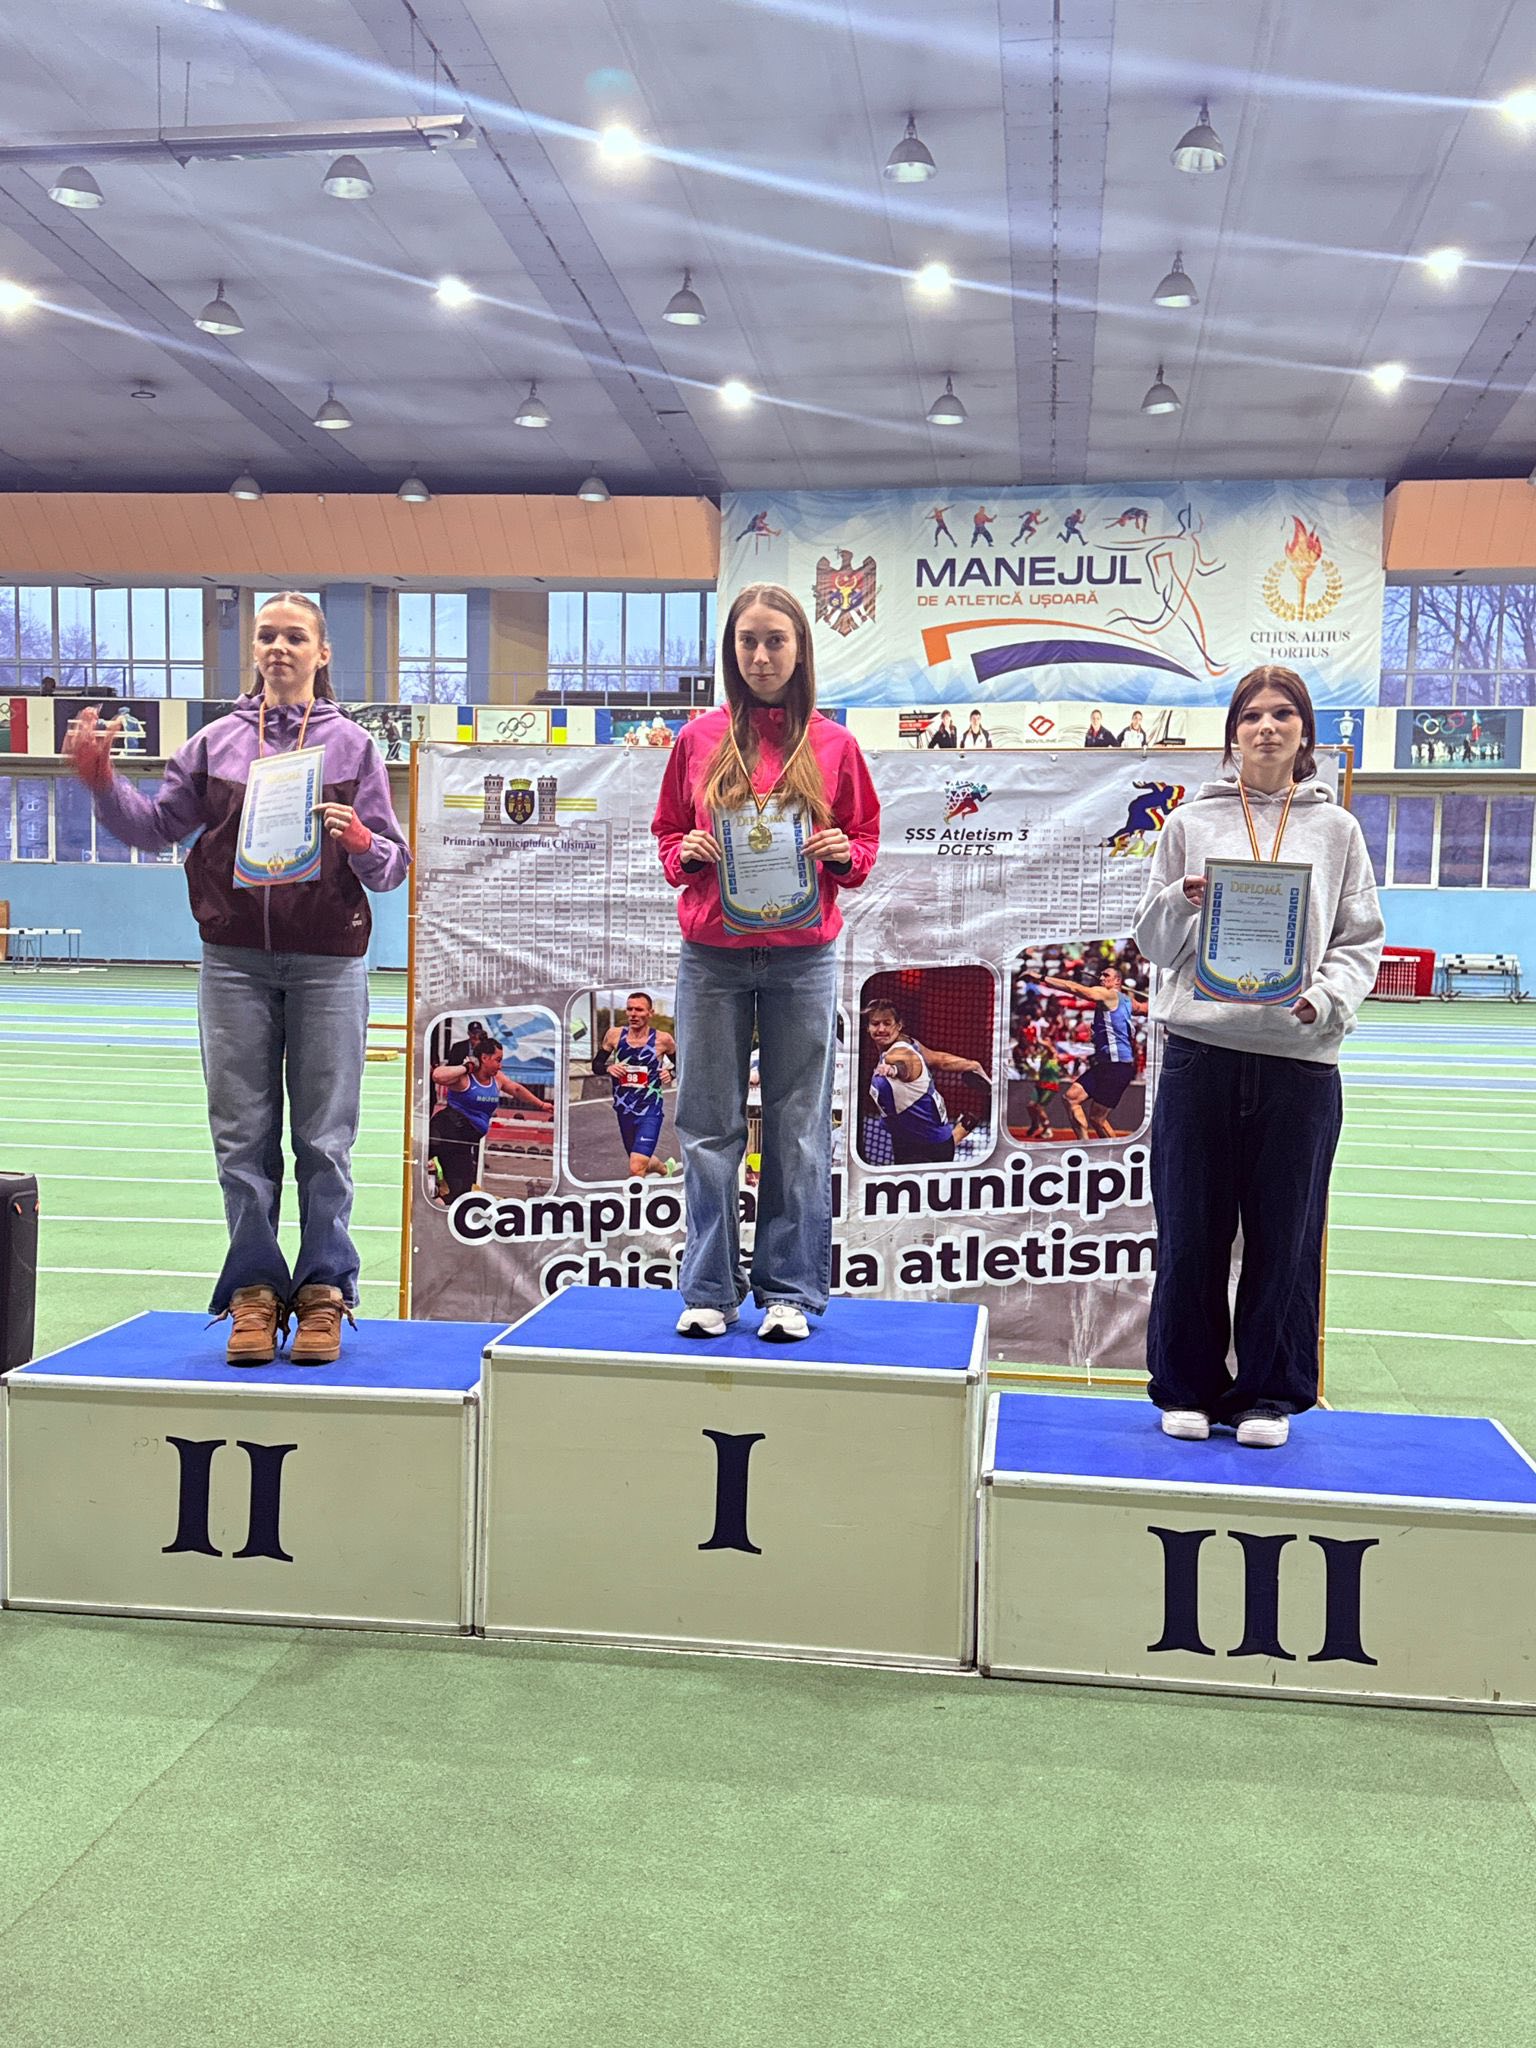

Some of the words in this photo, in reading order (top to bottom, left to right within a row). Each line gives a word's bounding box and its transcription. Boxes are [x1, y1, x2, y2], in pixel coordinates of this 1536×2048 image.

[916, 556, 1142, 587] MANEJUL
[918, 595, 938, 606] DE
[945, 591, 1023, 606] ATLETICĂ
[1030, 591, 1098, 608] UȘOARĂ
[1302, 631, 1351, 643] ALTIUS
[1270, 647, 1329, 658] FORTIUS
[489, 837, 550, 850] Municipiului
[941, 827, 1013, 841] Atletism
[1018, 829, 1029, 841] 3
[938, 844, 994, 856] DGETS
[865, 1151, 1145, 1215] municipi
[831, 1244, 879, 1288] la
[900, 1228, 1157, 1285] atletism
[162, 1435, 298, 1563] II
[698, 1428, 766, 1555] I
[1147, 1526, 1380, 1666] III
